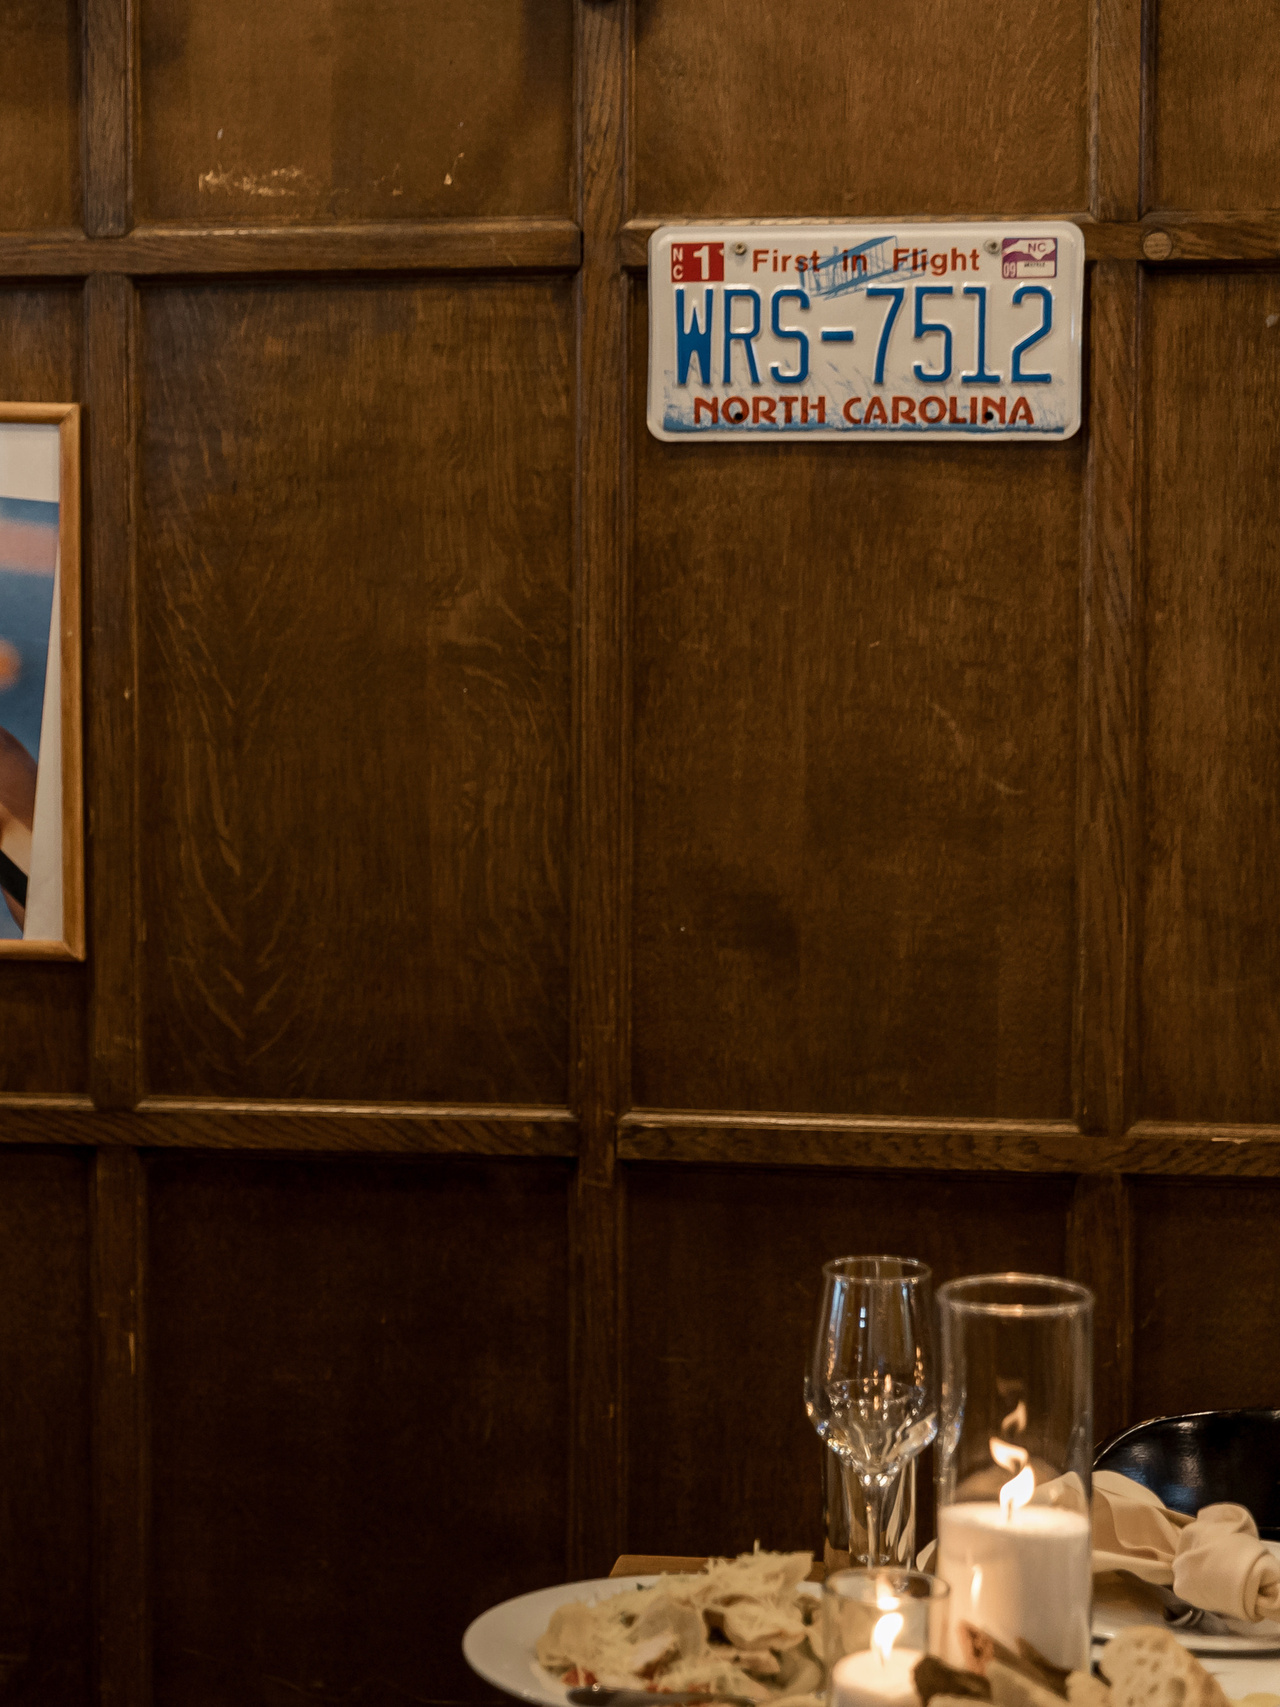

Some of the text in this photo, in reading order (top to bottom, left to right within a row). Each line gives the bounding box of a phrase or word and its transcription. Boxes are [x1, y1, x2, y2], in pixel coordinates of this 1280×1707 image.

[752, 247, 980, 275] First in Flight
[1028, 242, 1046, 252] NC
[675, 285, 1053, 385] WRS-7512
[694, 396, 1034, 424] NORTH CAROLINA
